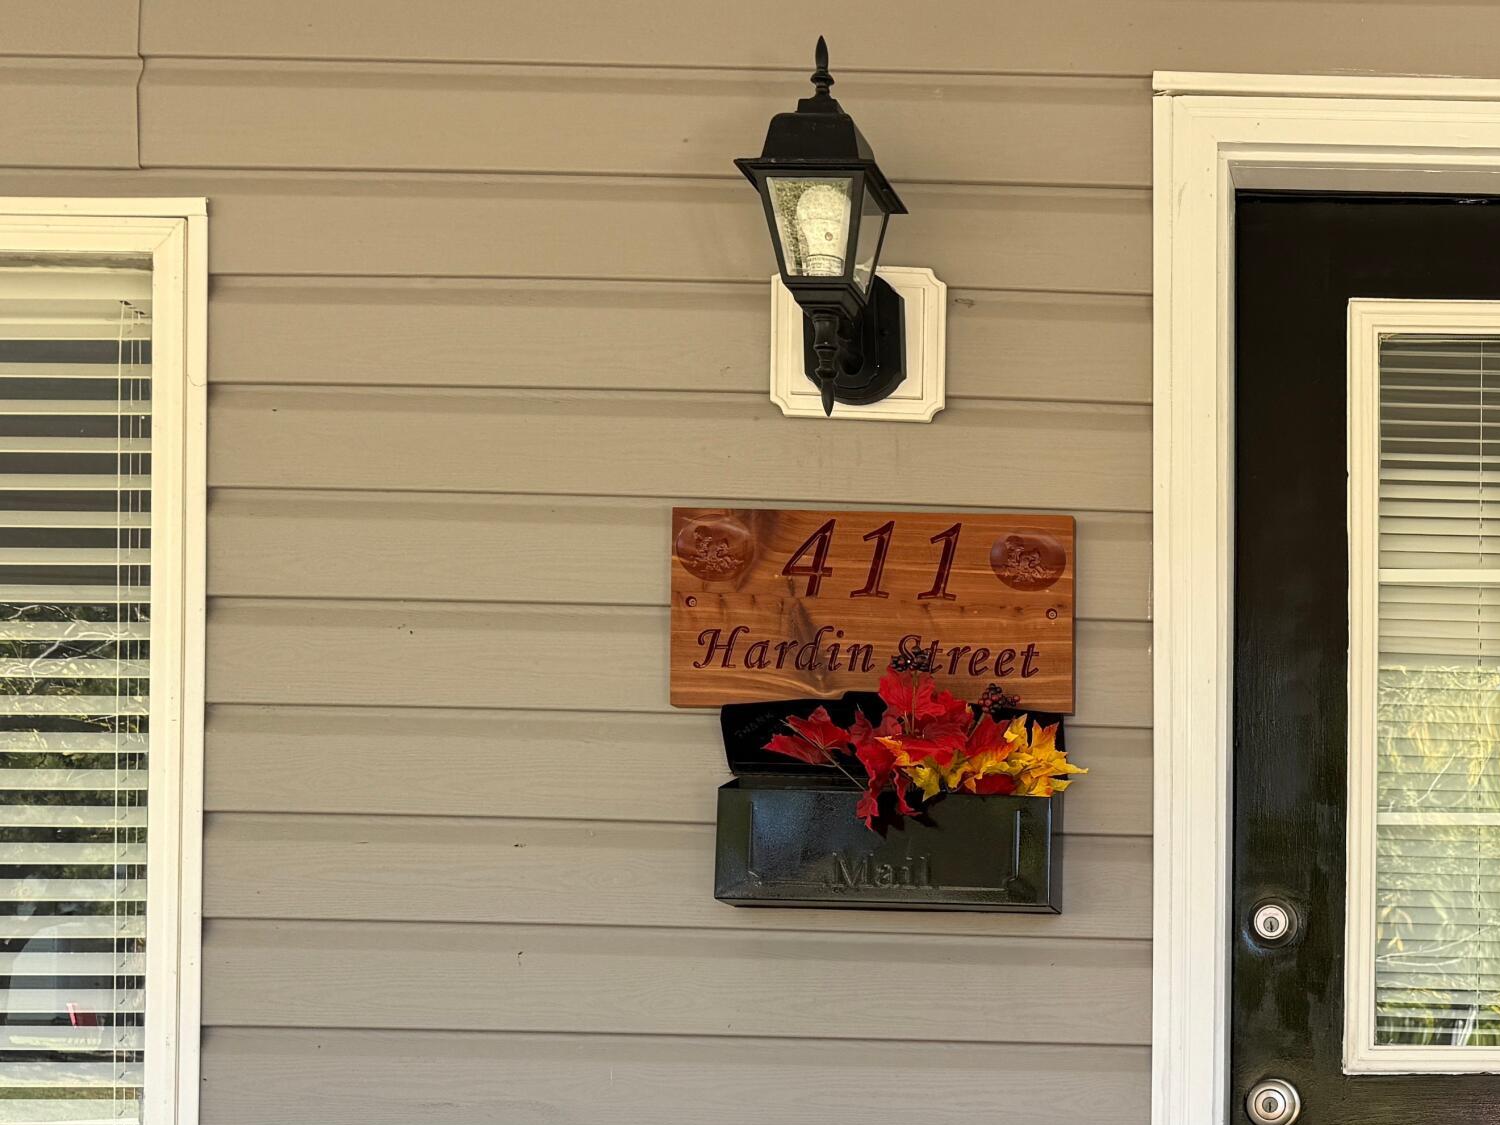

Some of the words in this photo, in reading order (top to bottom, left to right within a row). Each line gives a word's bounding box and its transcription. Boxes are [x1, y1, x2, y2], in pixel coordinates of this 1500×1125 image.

[782, 518, 963, 601] 411
[693, 625, 875, 673] Hardin
[898, 634, 1040, 678] Street
[832, 851, 931, 888] Mail
